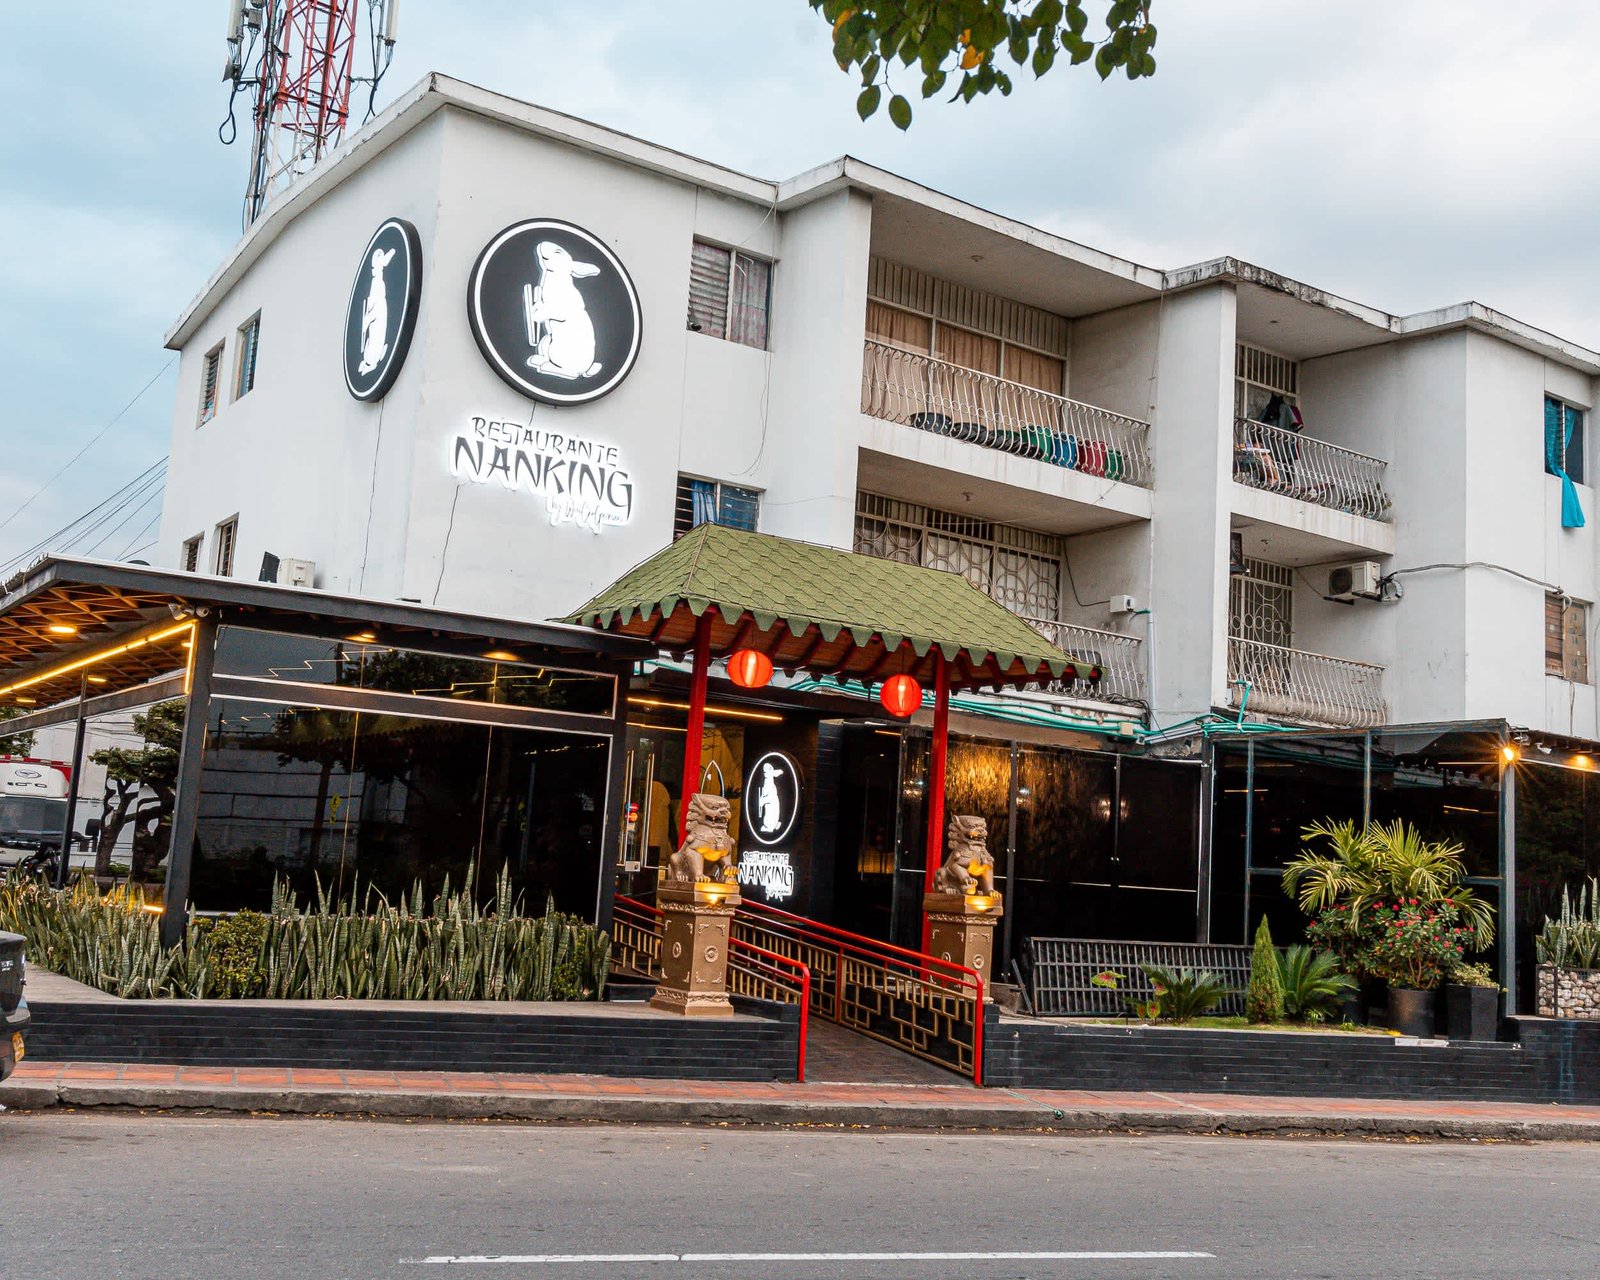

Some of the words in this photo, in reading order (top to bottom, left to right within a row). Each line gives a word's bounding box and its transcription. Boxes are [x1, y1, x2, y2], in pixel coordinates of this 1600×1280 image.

[471, 416, 618, 467] RESTAURANTE
[455, 435, 633, 521] NANKING
[739, 863, 793, 892] NANKING
[743, 851, 789, 866] RESTAURANTE
